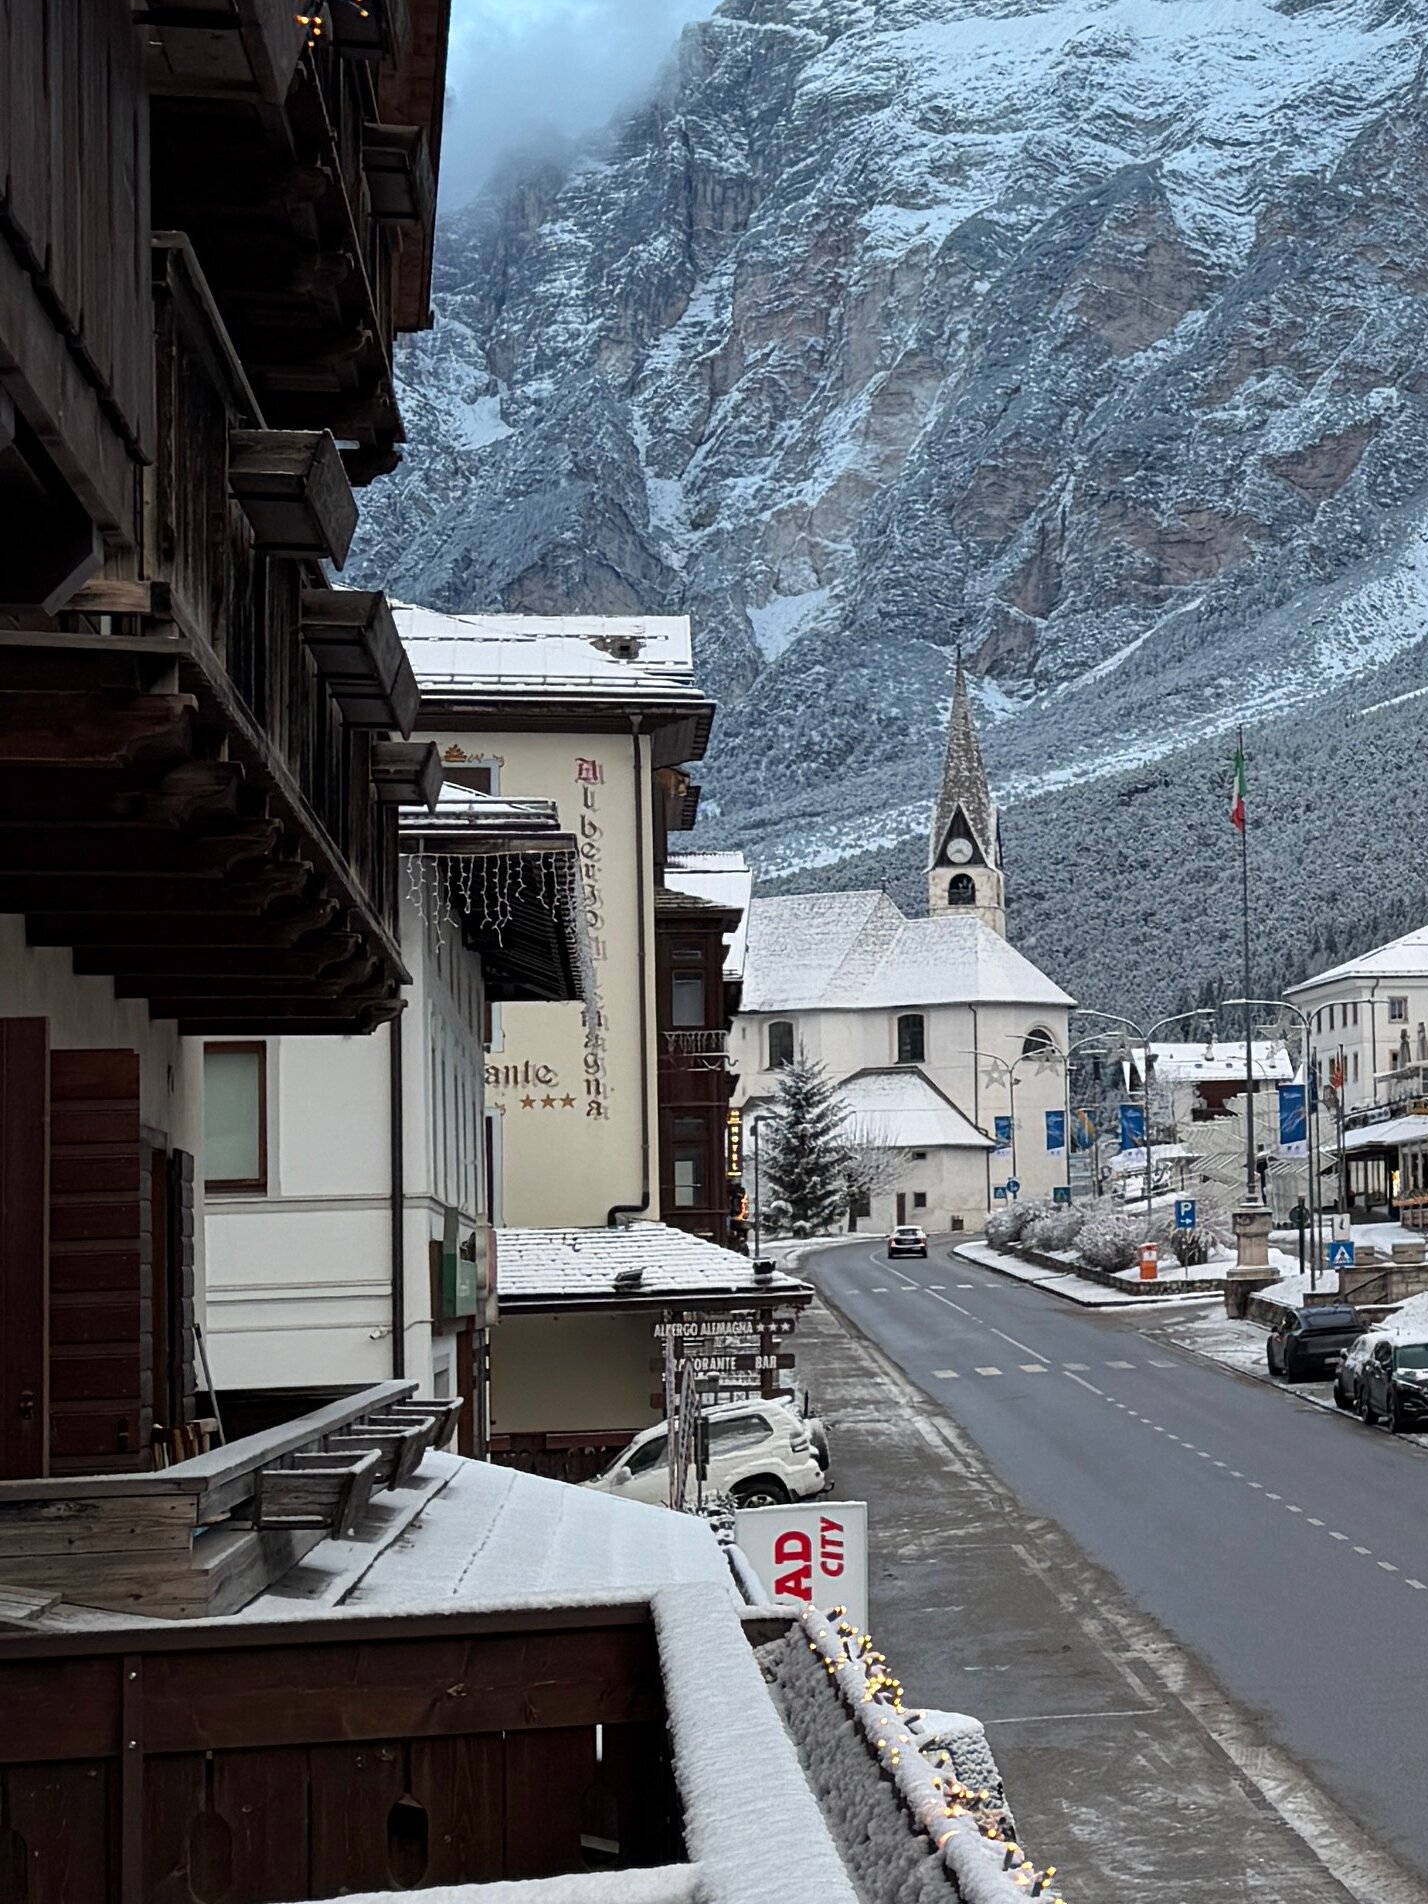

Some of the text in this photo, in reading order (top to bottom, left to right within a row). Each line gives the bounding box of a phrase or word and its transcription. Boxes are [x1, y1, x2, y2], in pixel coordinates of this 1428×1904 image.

[483, 1062, 552, 1086] ante
[731, 1126, 739, 1171] HOTEL
[1180, 1202, 1192, 1216] P
[700, 1321, 754, 1335] ALEMAGNA
[755, 1355, 778, 1369] BAR
[820, 1516, 844, 1577] CITY
[775, 1530, 812, 1602] AD
